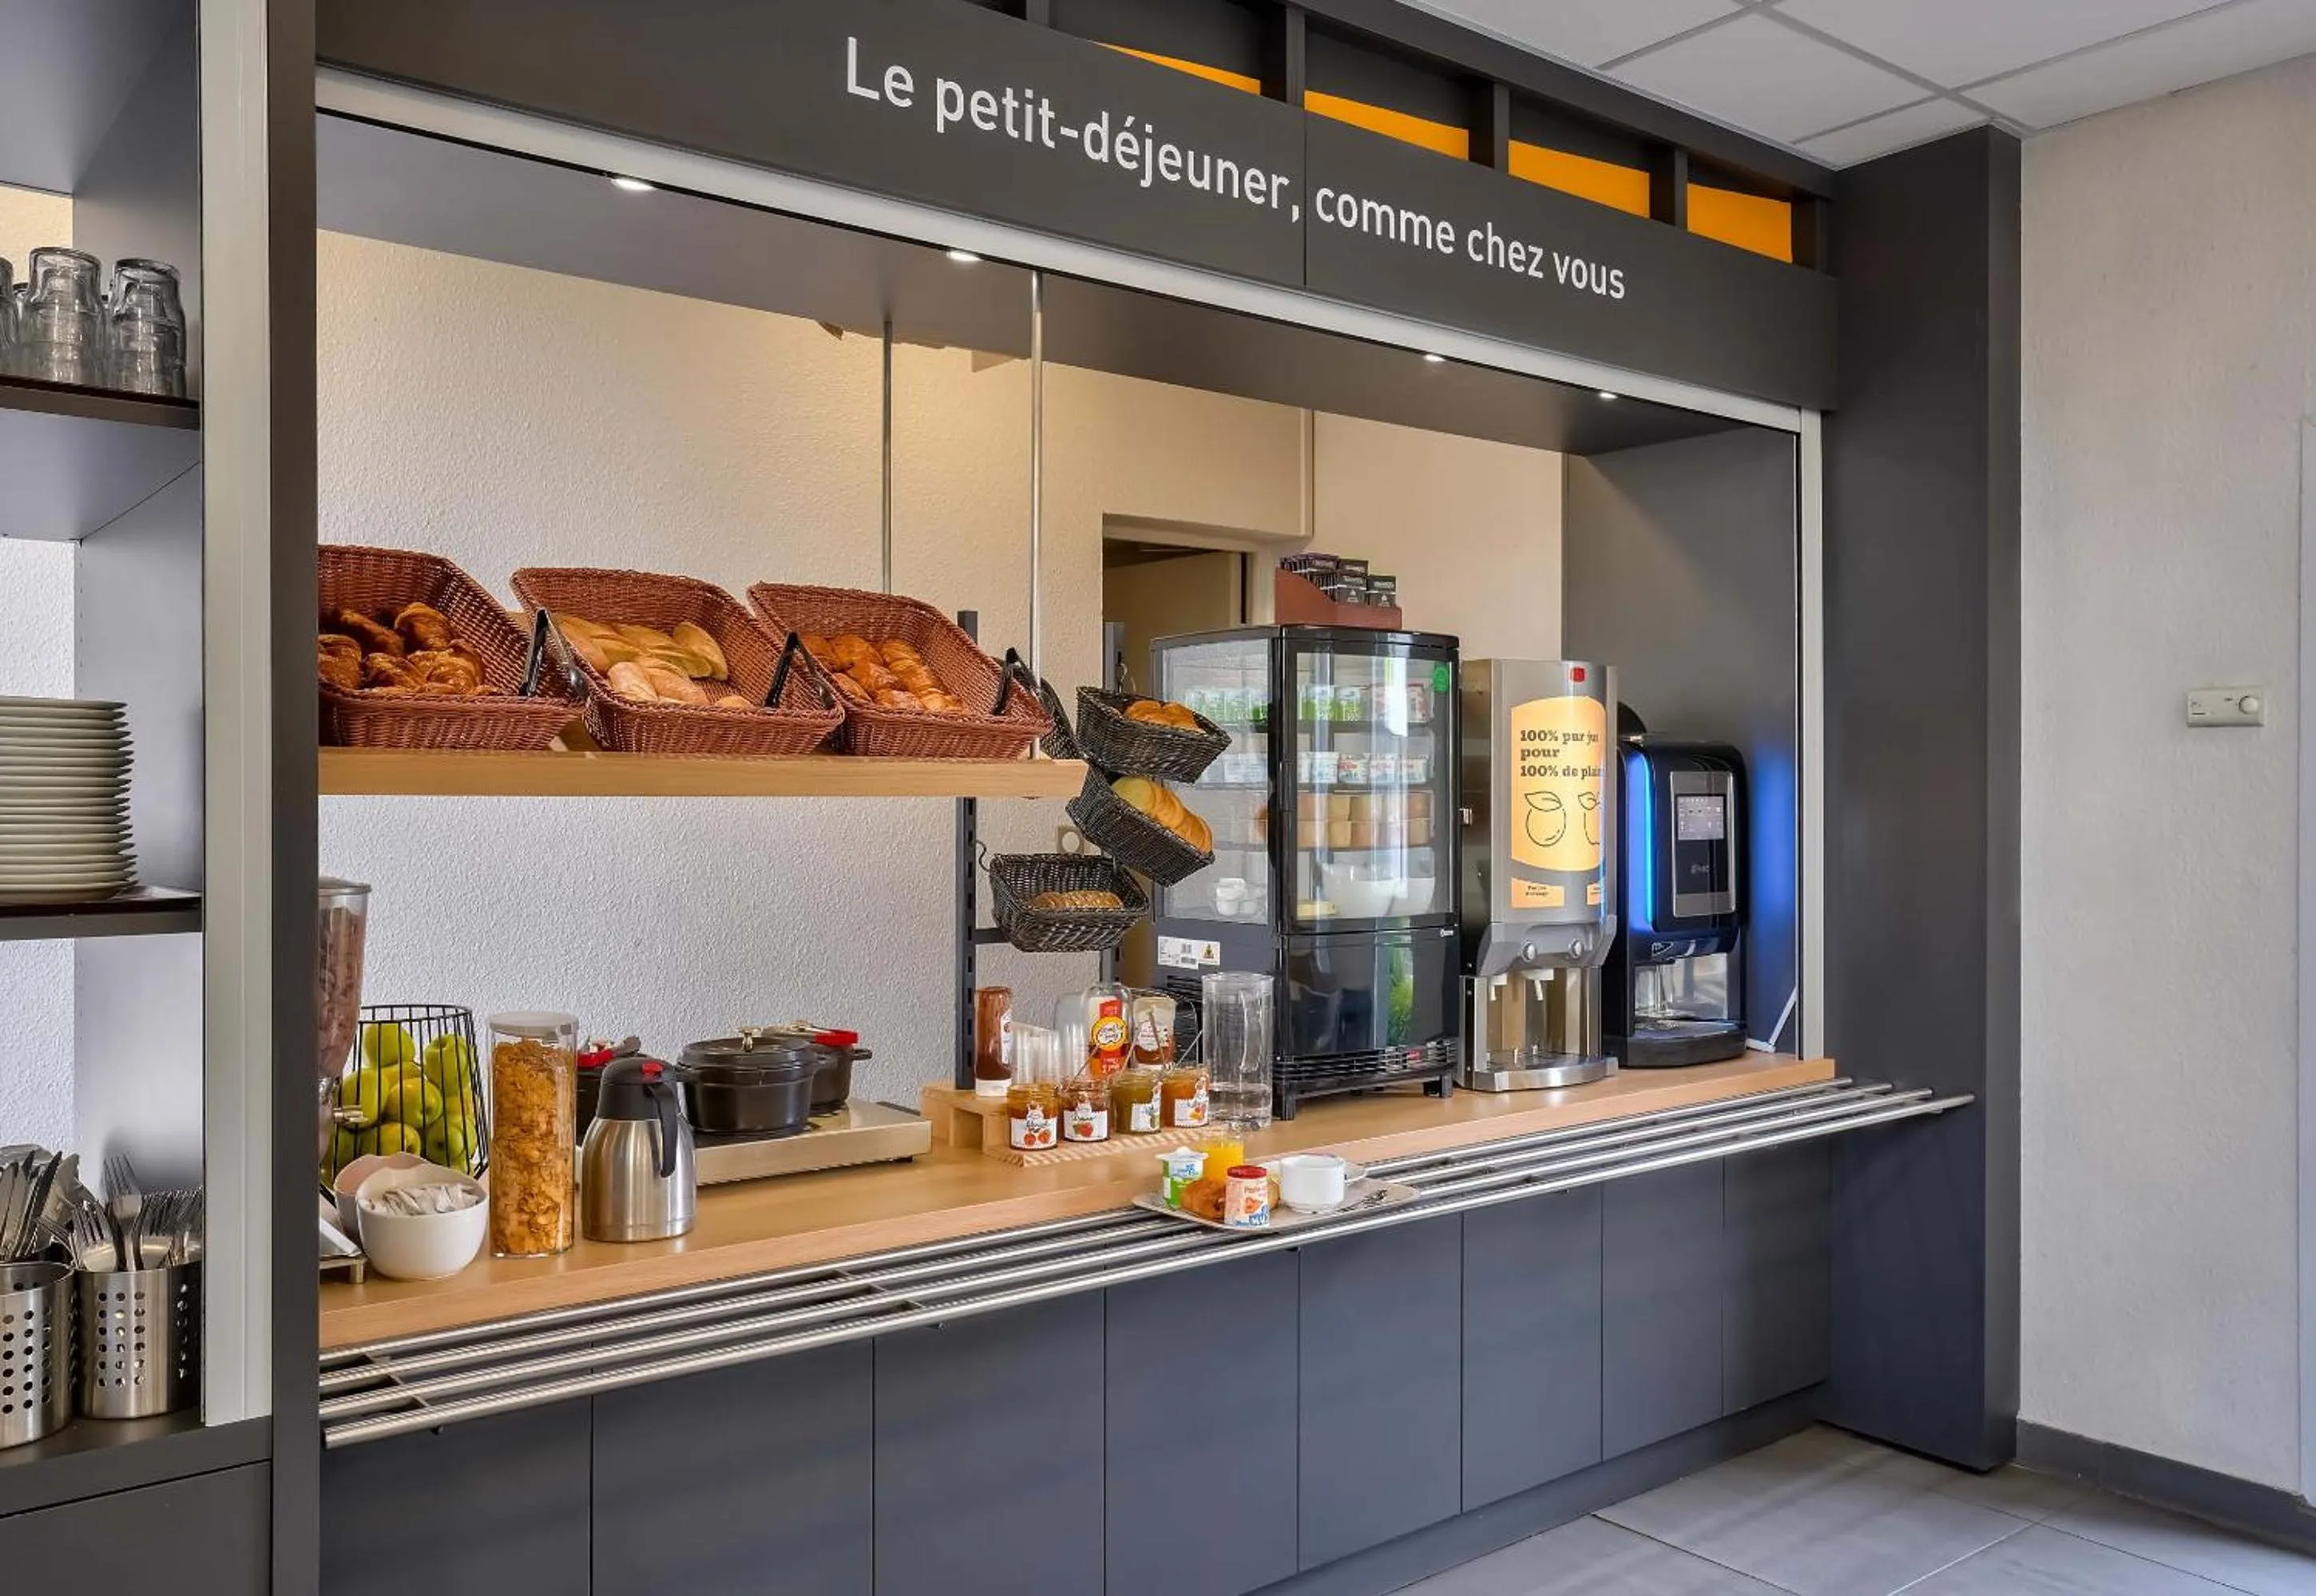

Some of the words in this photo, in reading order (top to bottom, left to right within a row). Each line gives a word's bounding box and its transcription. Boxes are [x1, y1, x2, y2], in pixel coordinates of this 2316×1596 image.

[846, 36, 915, 109] Le
[936, 77, 1300, 224] petit-déjeuner,
[1315, 187, 1456, 255] comme
[1466, 221, 1545, 279] chez
[1552, 251, 1626, 300] vous
[1520, 730, 1558, 742] 100%
[1562, 732, 1584, 745] pur
[1586, 731, 1600, 746] ju
[1520, 748, 1560, 762] pour
[1520, 765, 1558, 777] 100%
[1562, 766, 1579, 777] de
